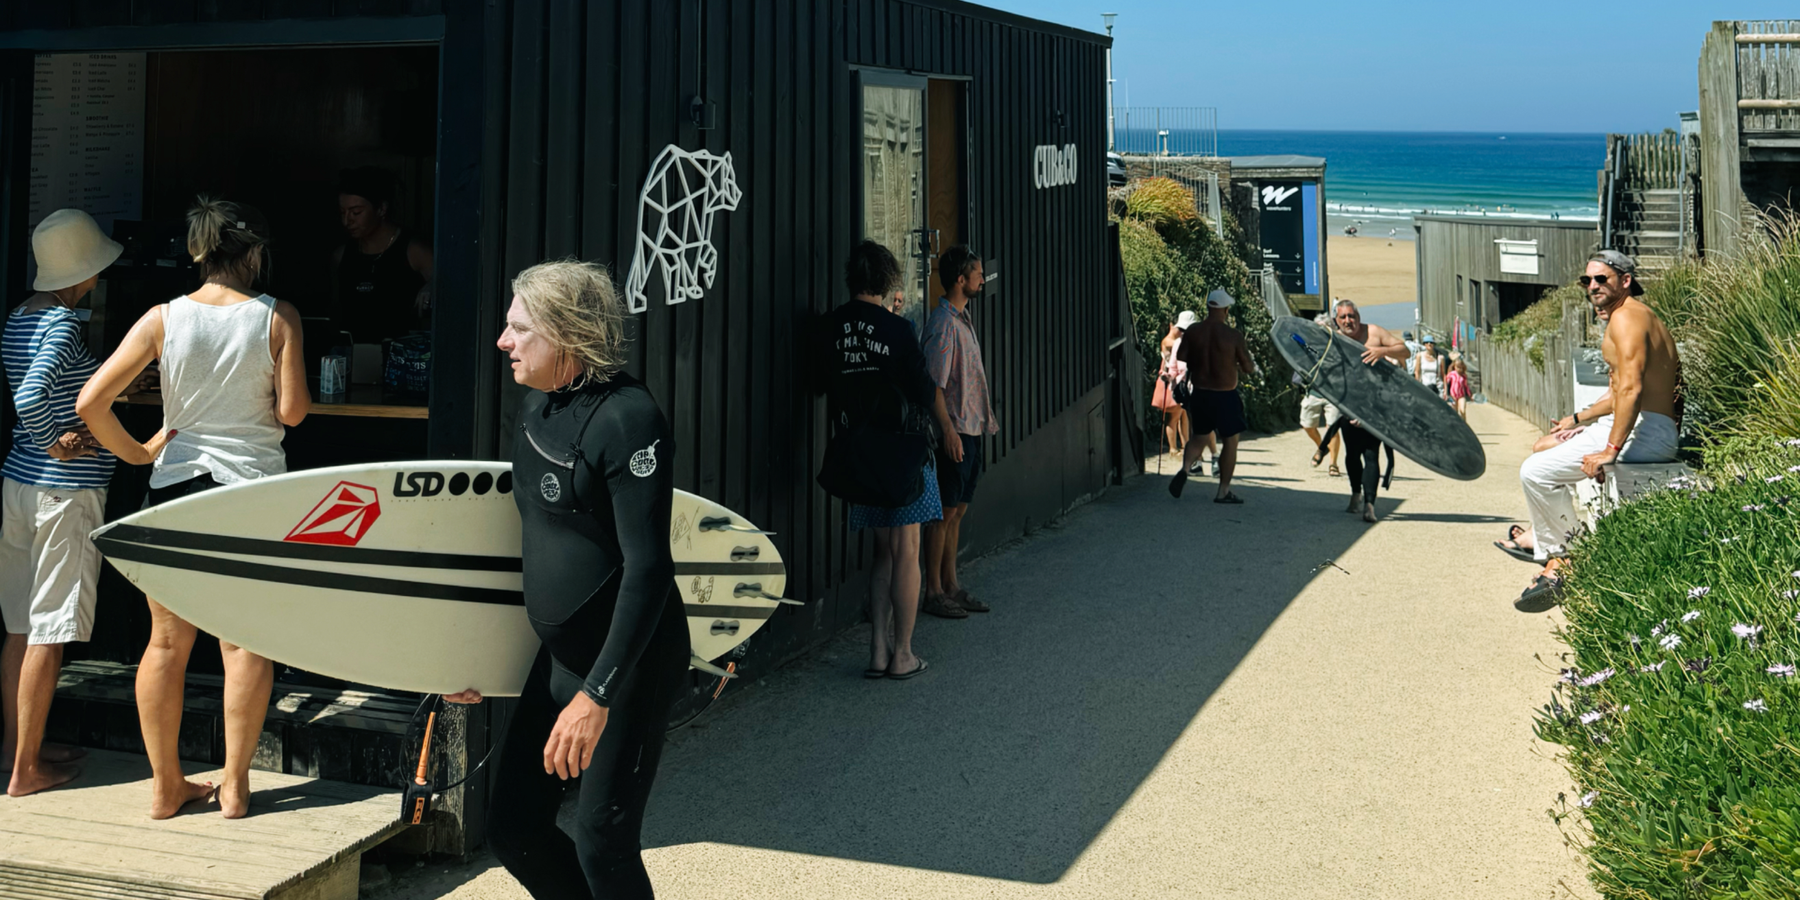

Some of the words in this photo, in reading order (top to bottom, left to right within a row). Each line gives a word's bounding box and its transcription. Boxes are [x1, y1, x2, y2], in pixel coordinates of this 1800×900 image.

[1033, 143, 1078, 190] CUB&CO
[843, 320, 875, 335] DUS
[844, 351, 869, 363] TOKY
[392, 472, 445, 497] LSD
